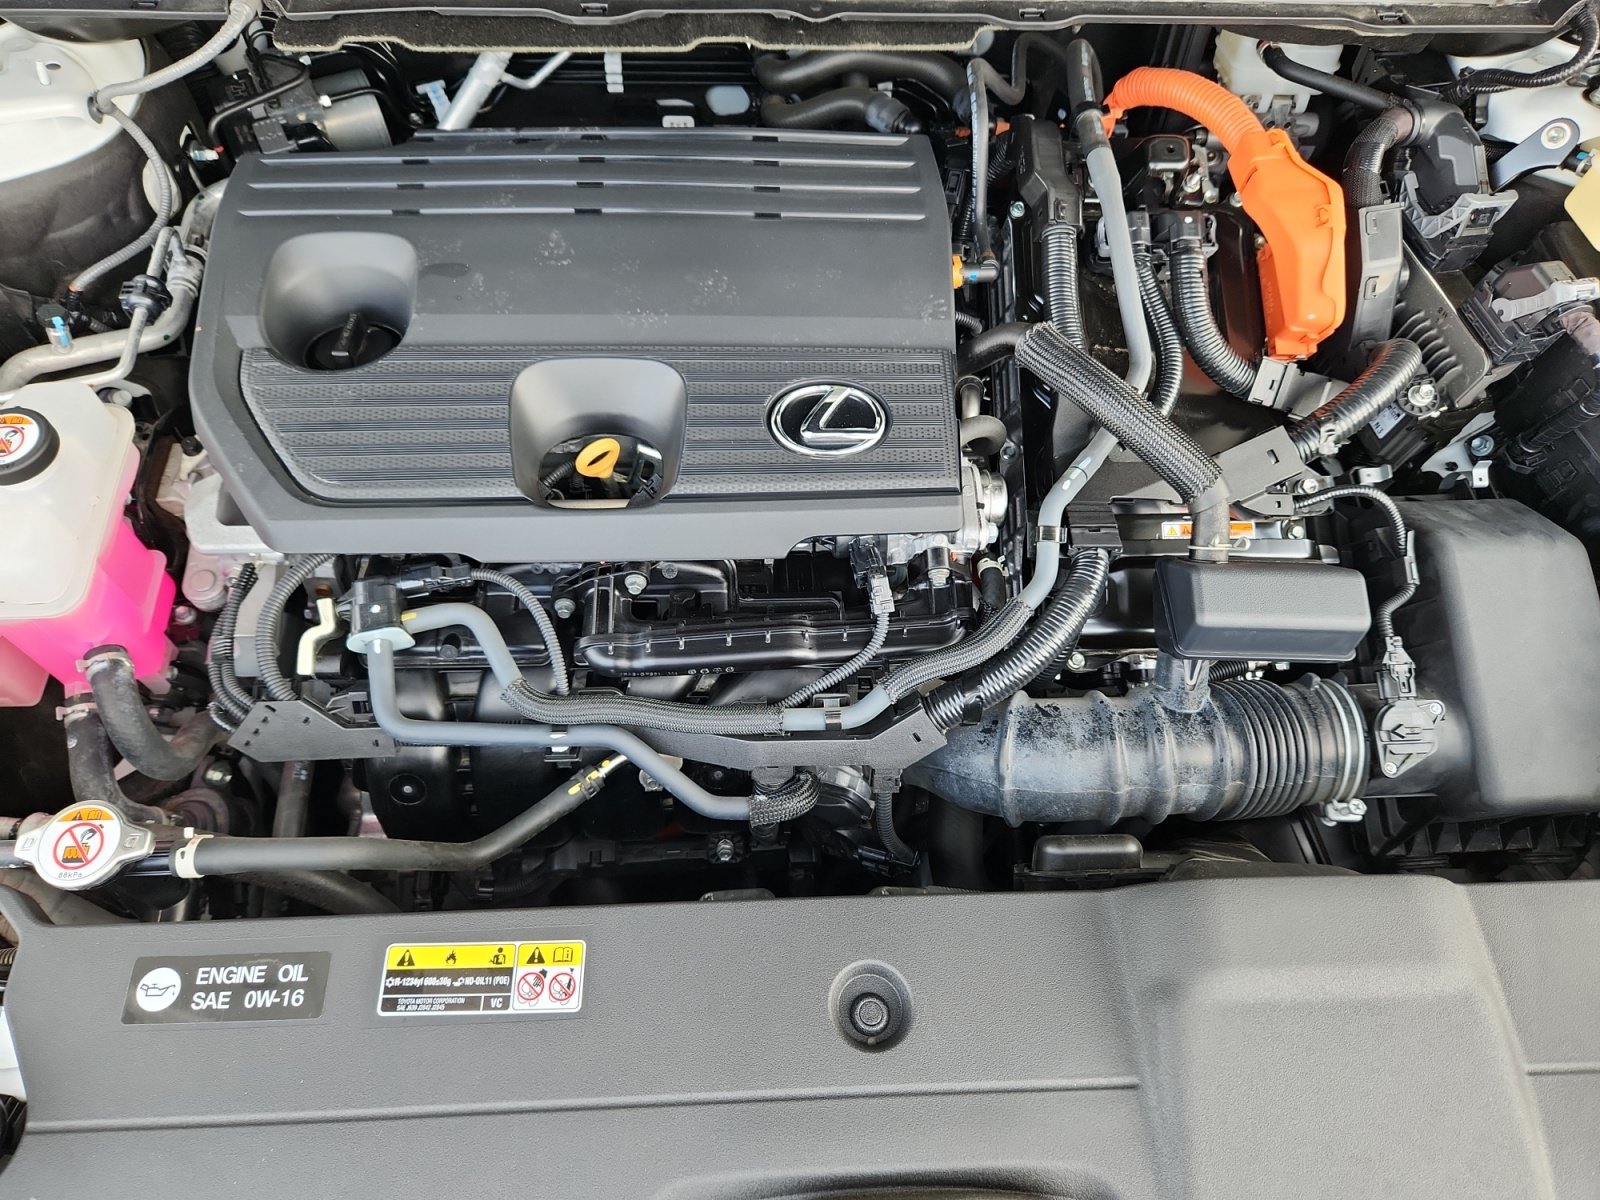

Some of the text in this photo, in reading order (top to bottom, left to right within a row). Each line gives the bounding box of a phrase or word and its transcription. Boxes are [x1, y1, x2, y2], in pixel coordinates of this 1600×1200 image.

[195, 964, 309, 985] ENGINE OIL
[464, 976, 492, 986] ND-OIL11
[493, 976, 510, 986] (POE)
[190, 989, 305, 1010] SAE 0W-16
[490, 997, 503, 1009] VC
